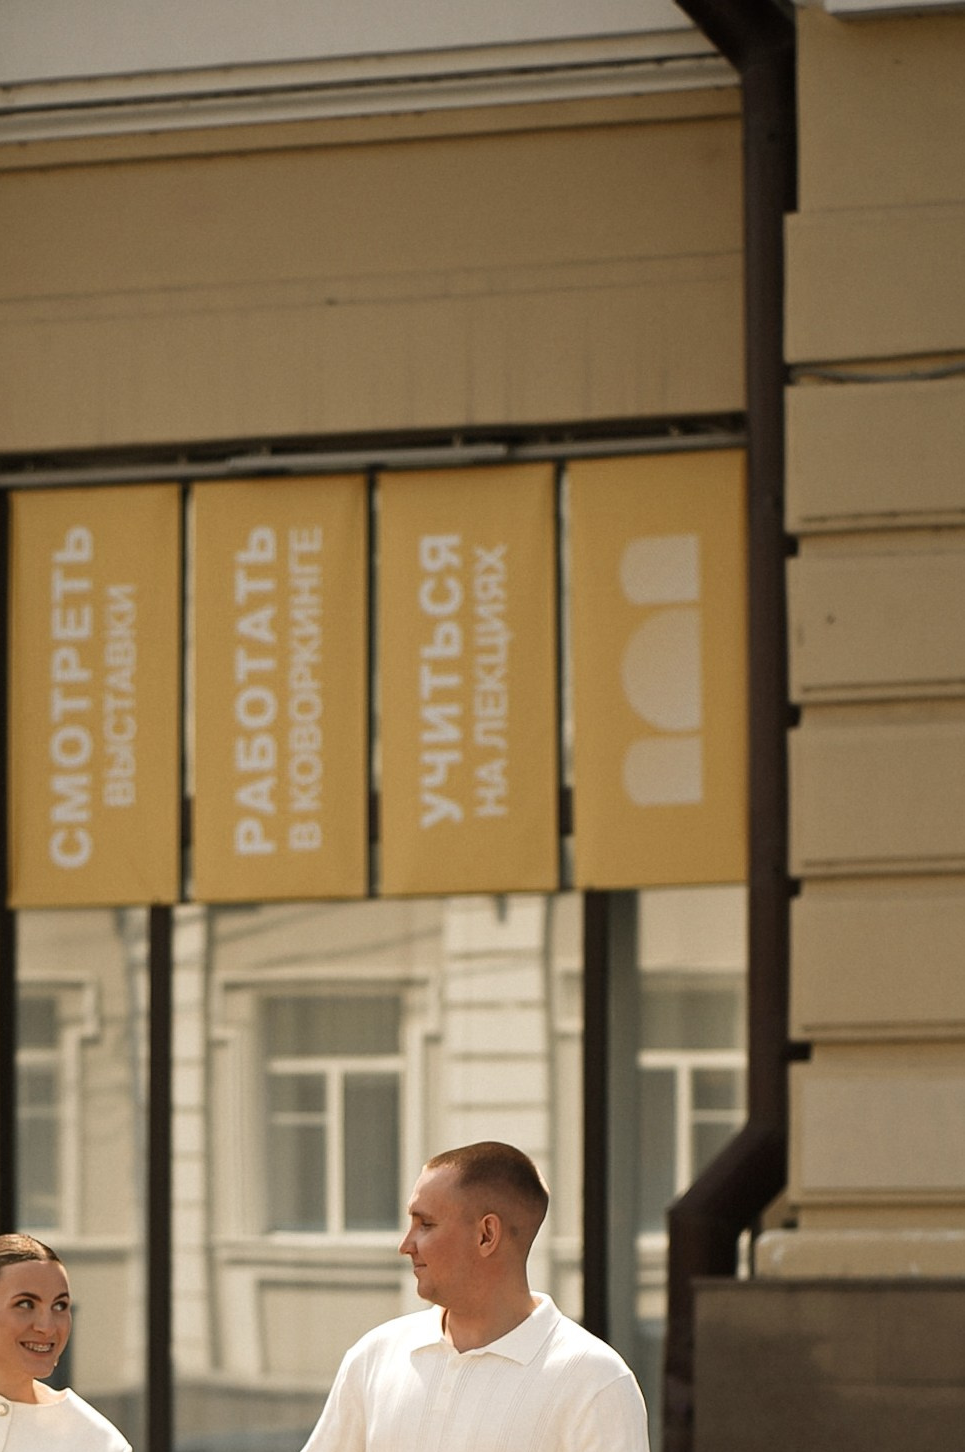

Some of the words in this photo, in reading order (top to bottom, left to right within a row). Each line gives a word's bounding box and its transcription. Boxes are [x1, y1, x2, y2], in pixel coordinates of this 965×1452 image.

[49, 525, 93, 870] СМОТРЕТЬ
[103, 583, 137, 809] ВЫСТАВКИ
[234, 525, 278, 857] РАБОТАТЬ
[288, 524, 322, 813] КОВОРКИНГЕ
[417, 532, 464, 831] УЧИТЬСЯ
[472, 542, 512, 751] ЛЕКЦИЯХ
[288, 820, 322, 853] В
[472, 757, 508, 819] НА
